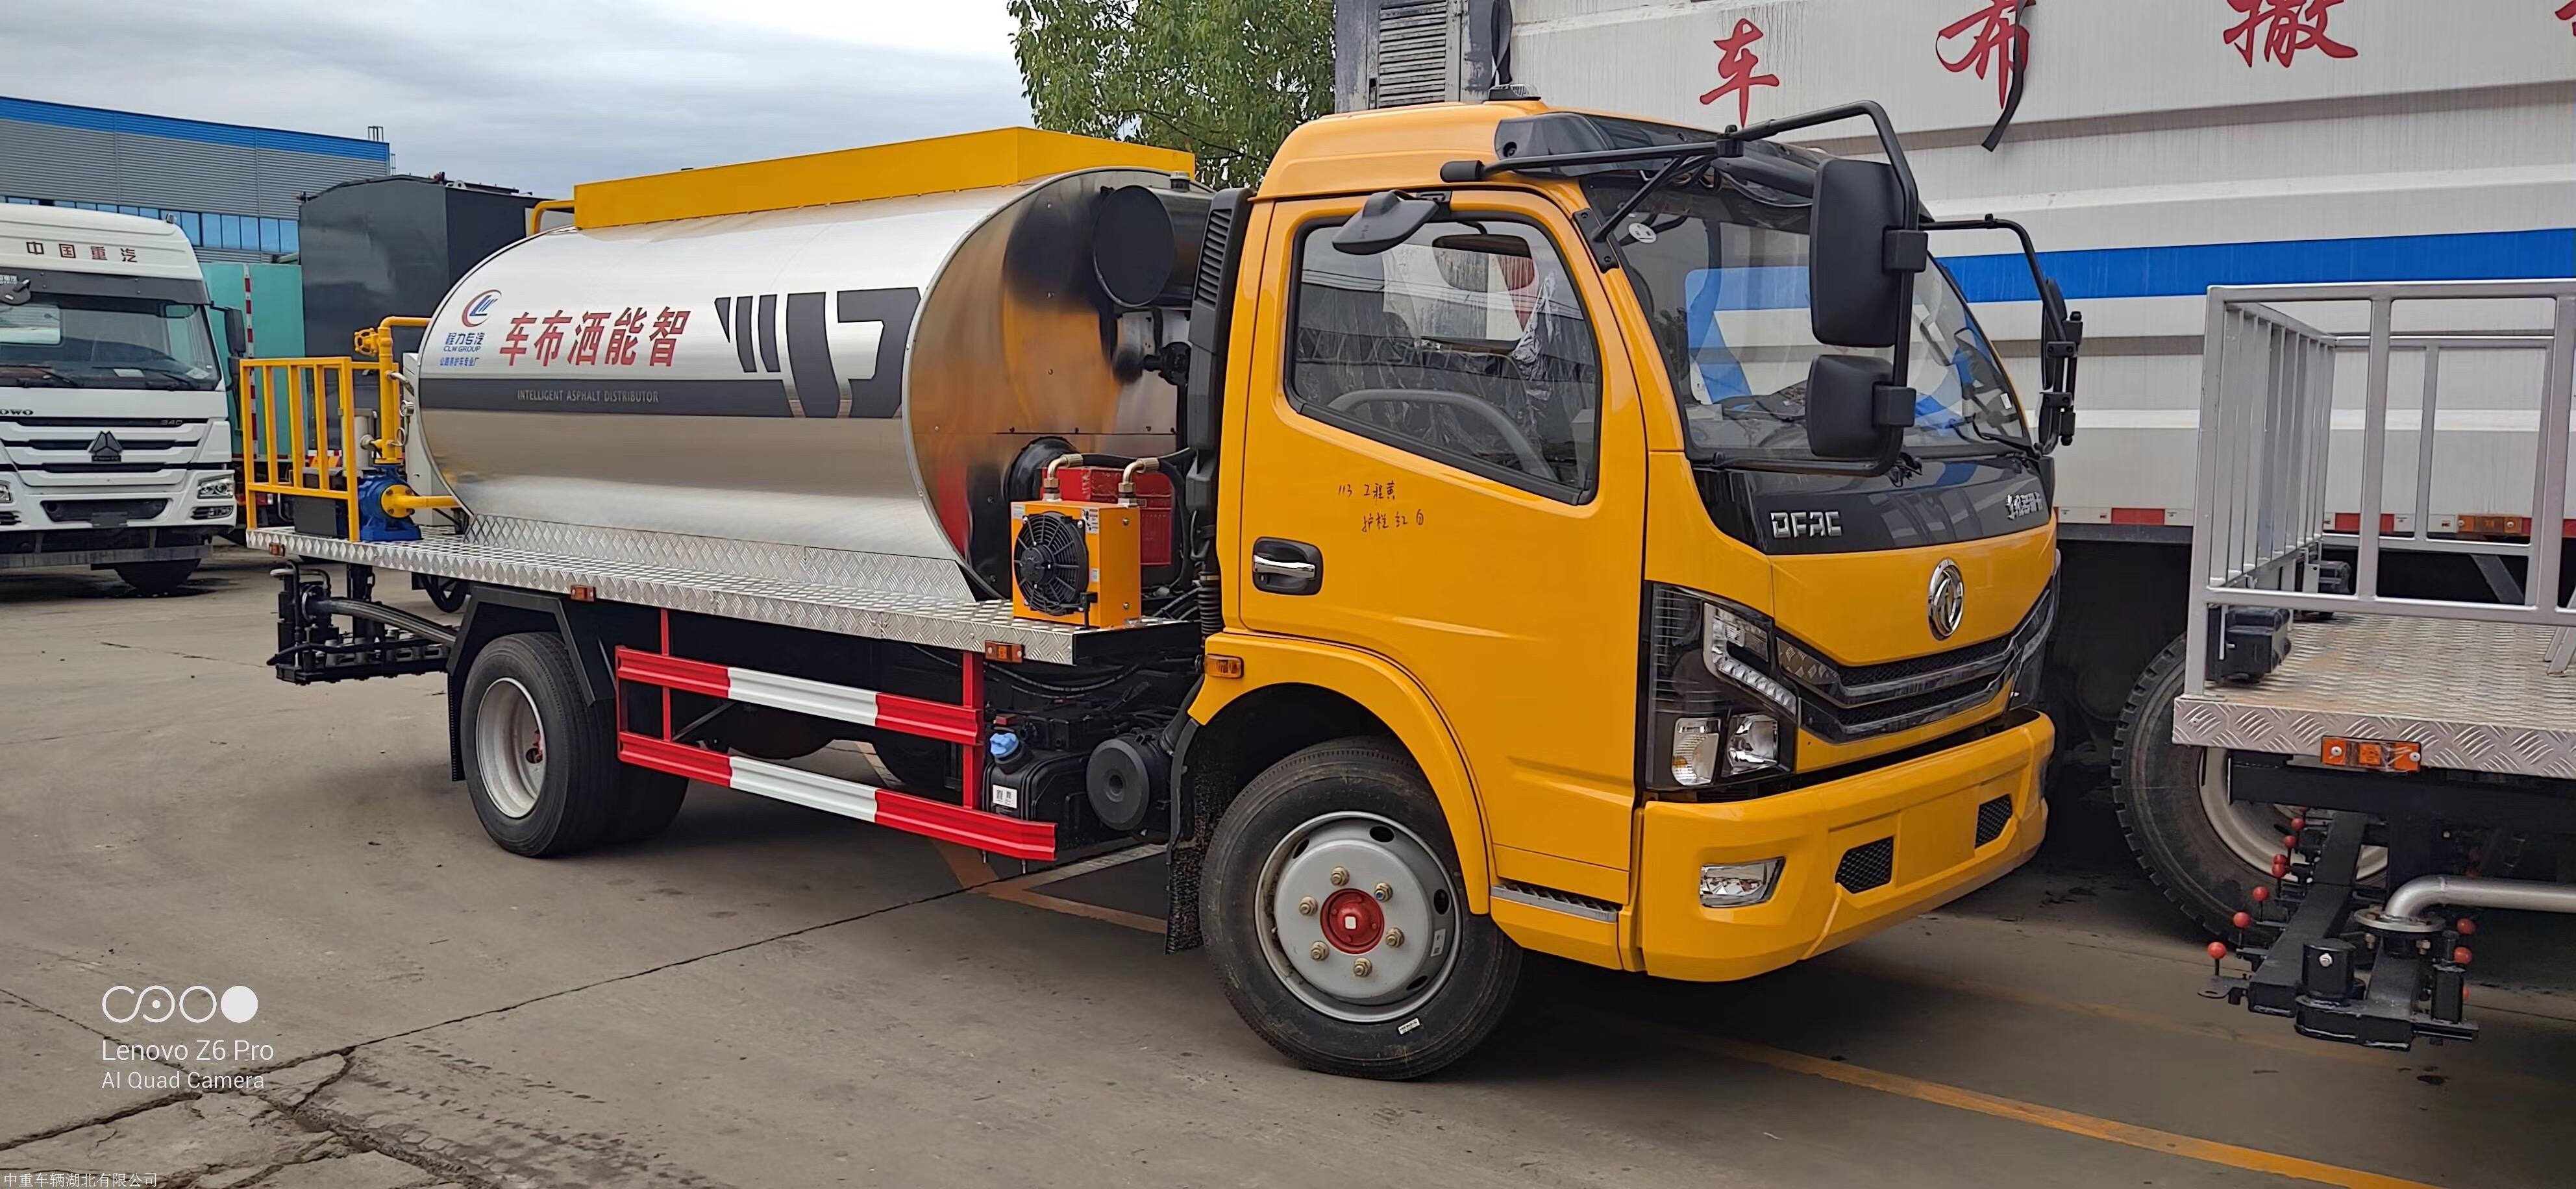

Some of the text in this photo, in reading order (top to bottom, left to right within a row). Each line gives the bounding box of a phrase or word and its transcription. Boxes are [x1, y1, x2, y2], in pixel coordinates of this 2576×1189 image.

[26, 241, 138, 263] 中国重汽
[517, 389, 659, 403] INTELLIGENT ASPHALT DISTRIBUTOR
[1770, 511, 1842, 539] DFAC
